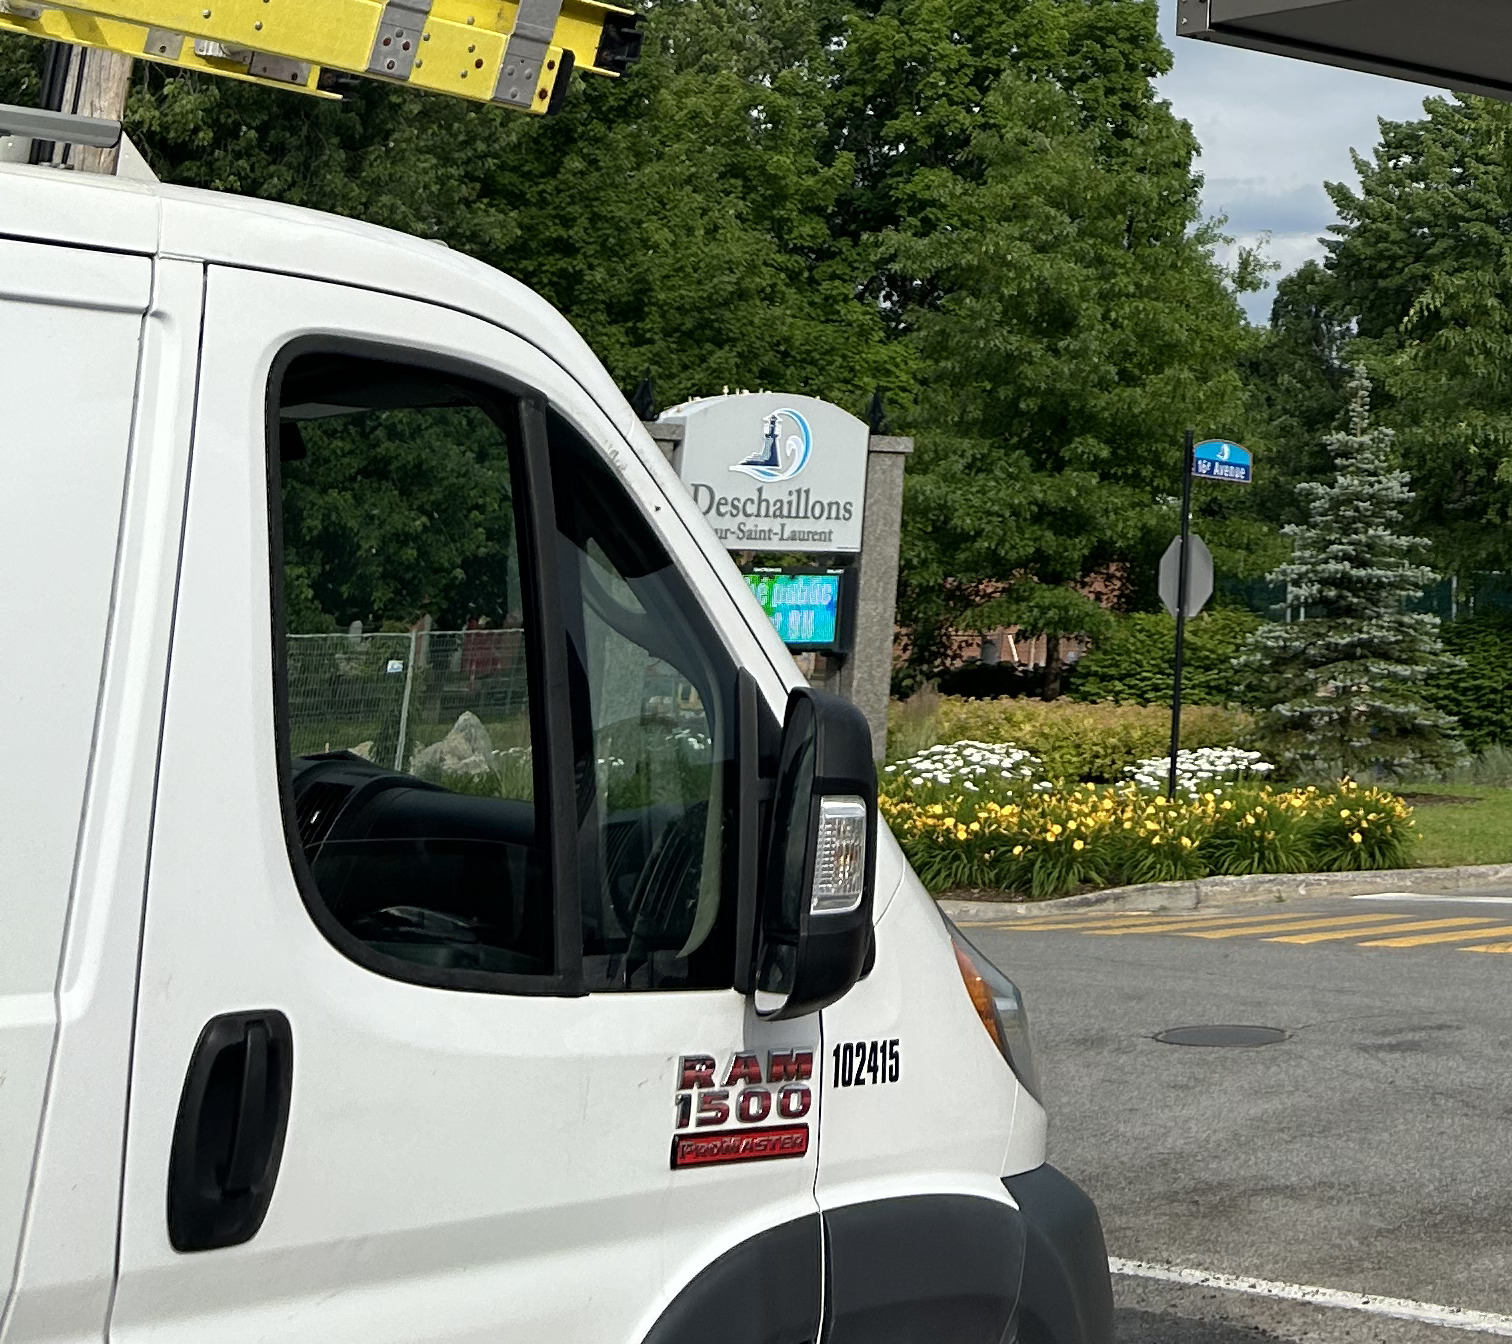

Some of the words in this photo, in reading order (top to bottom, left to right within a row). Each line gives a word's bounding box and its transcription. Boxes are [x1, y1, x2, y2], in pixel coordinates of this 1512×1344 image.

[690, 483, 854, 521] Deschaillons
[713, 522, 834, 543] ur-Saint-Laurent
[677, 1046, 814, 1091] RAM
[832, 1038, 900, 1089] 102415
[675, 1083, 812, 1129] 1500
